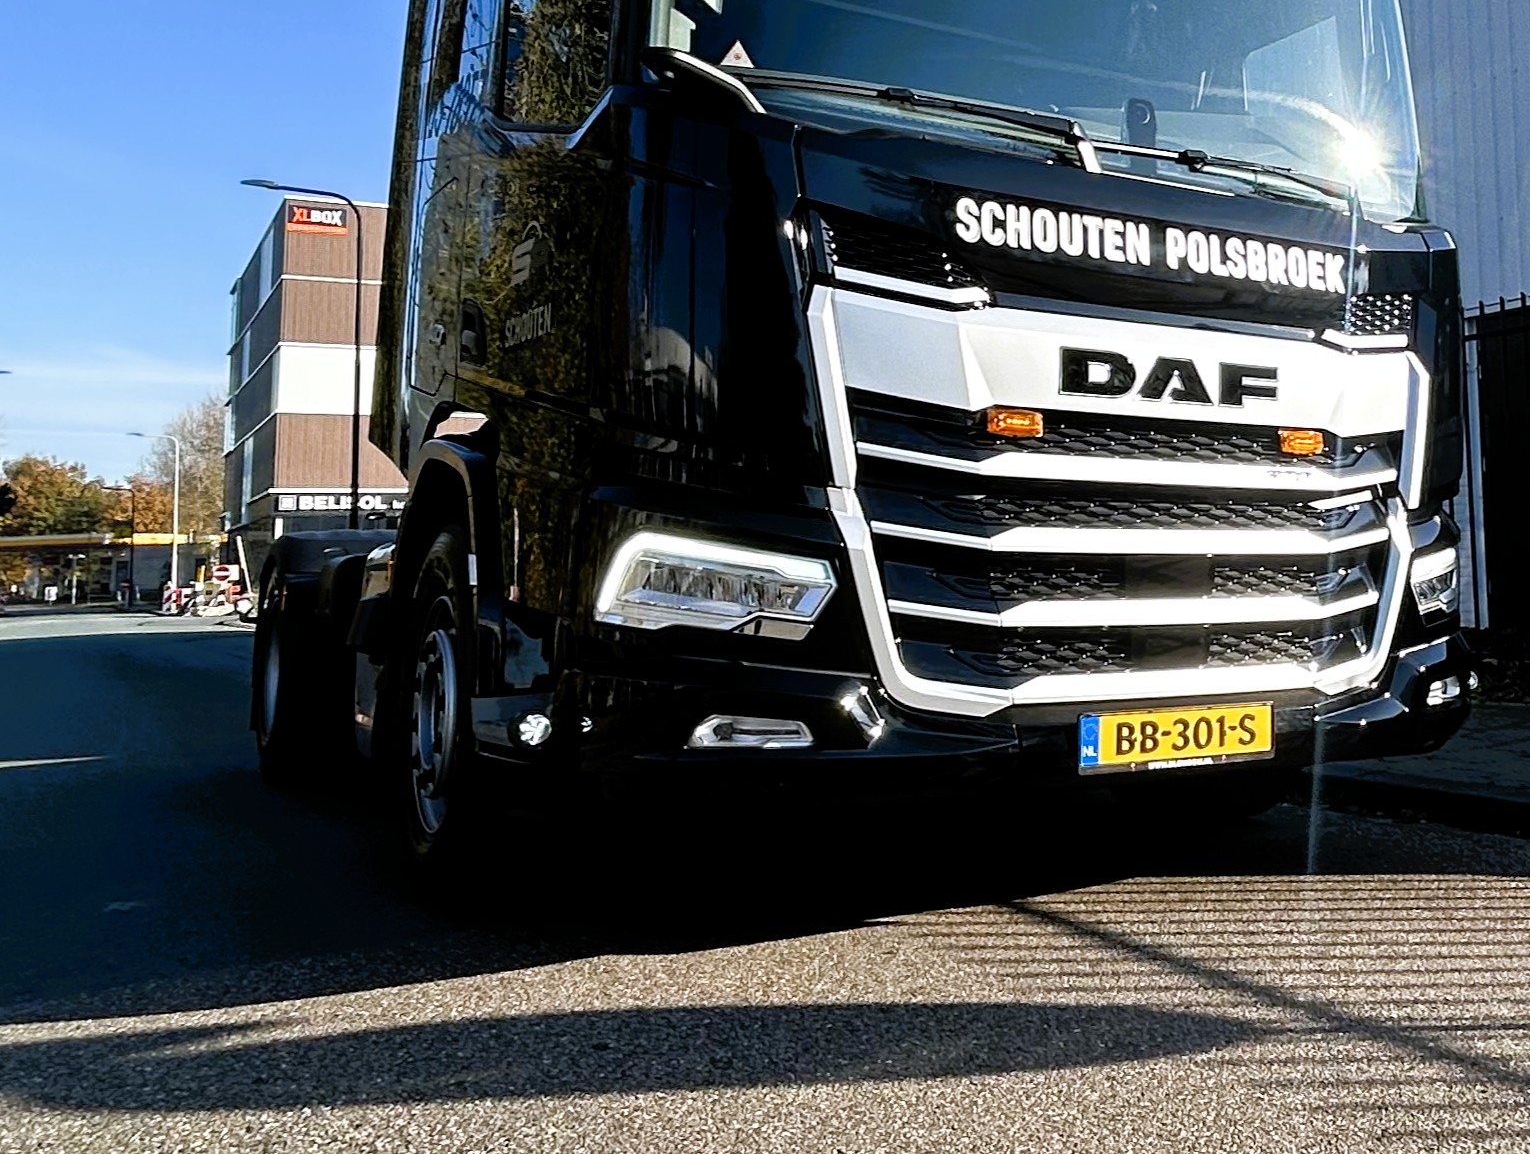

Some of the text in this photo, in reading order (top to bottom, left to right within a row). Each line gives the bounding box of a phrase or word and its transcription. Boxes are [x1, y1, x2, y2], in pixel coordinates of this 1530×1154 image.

[955, 197, 1346, 294] SCHOUTEN POLSBROEK
[1058, 345, 1279, 408] DAF
[1083, 746, 1097, 757] NL
[1115, 713, 1257, 756] BB-301-S
